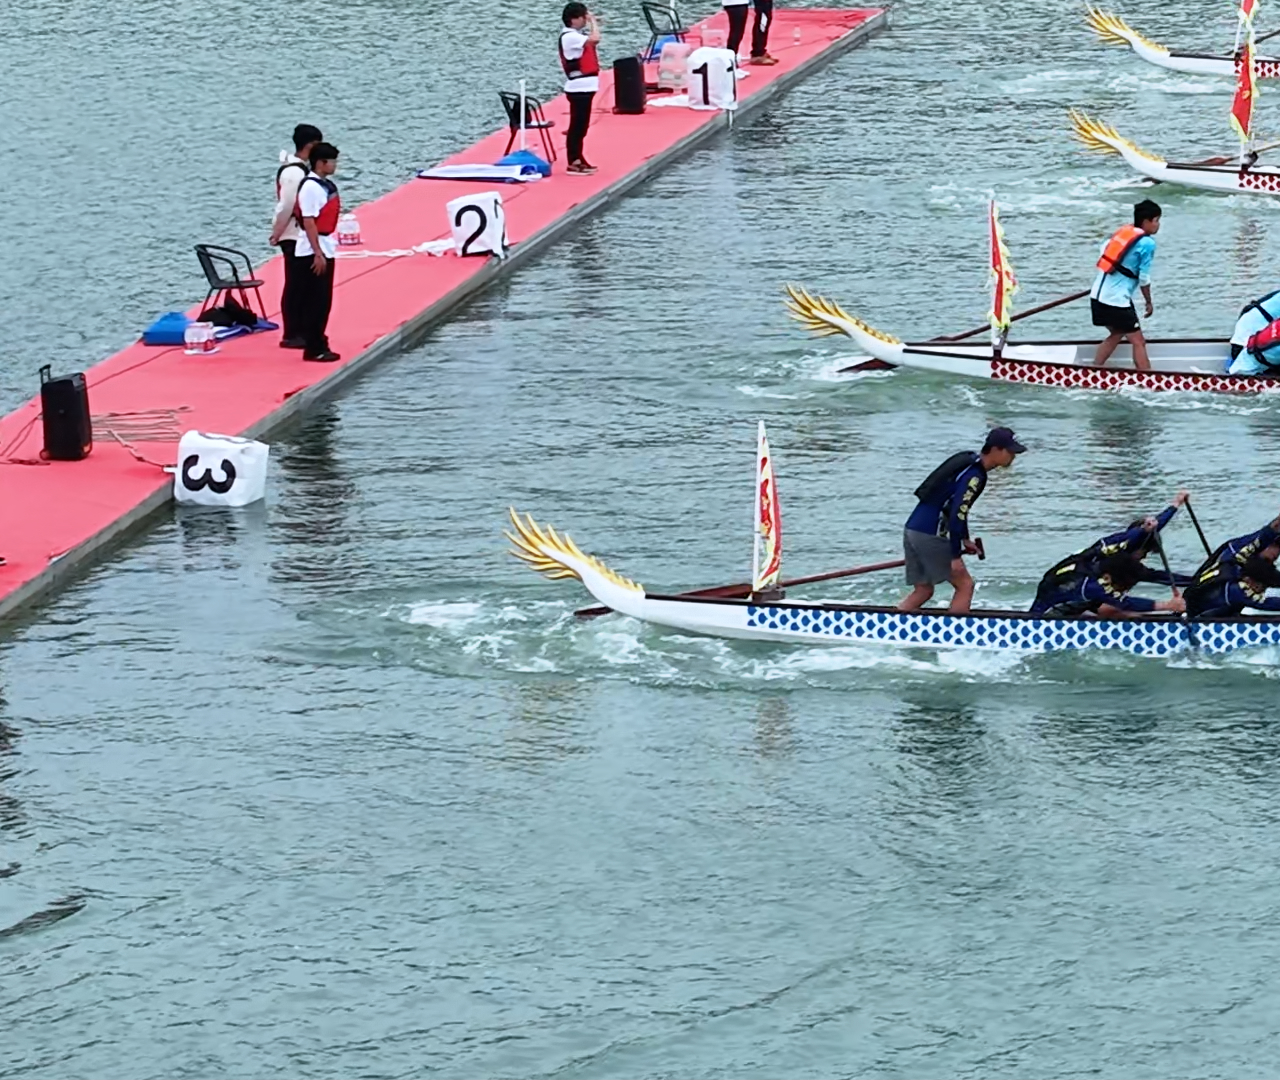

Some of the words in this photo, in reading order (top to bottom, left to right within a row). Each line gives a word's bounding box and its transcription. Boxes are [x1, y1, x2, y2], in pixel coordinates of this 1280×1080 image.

[692, 62, 710, 106] 1
[455, 205, 495, 257] 2
[182, 454, 236, 495] 3
